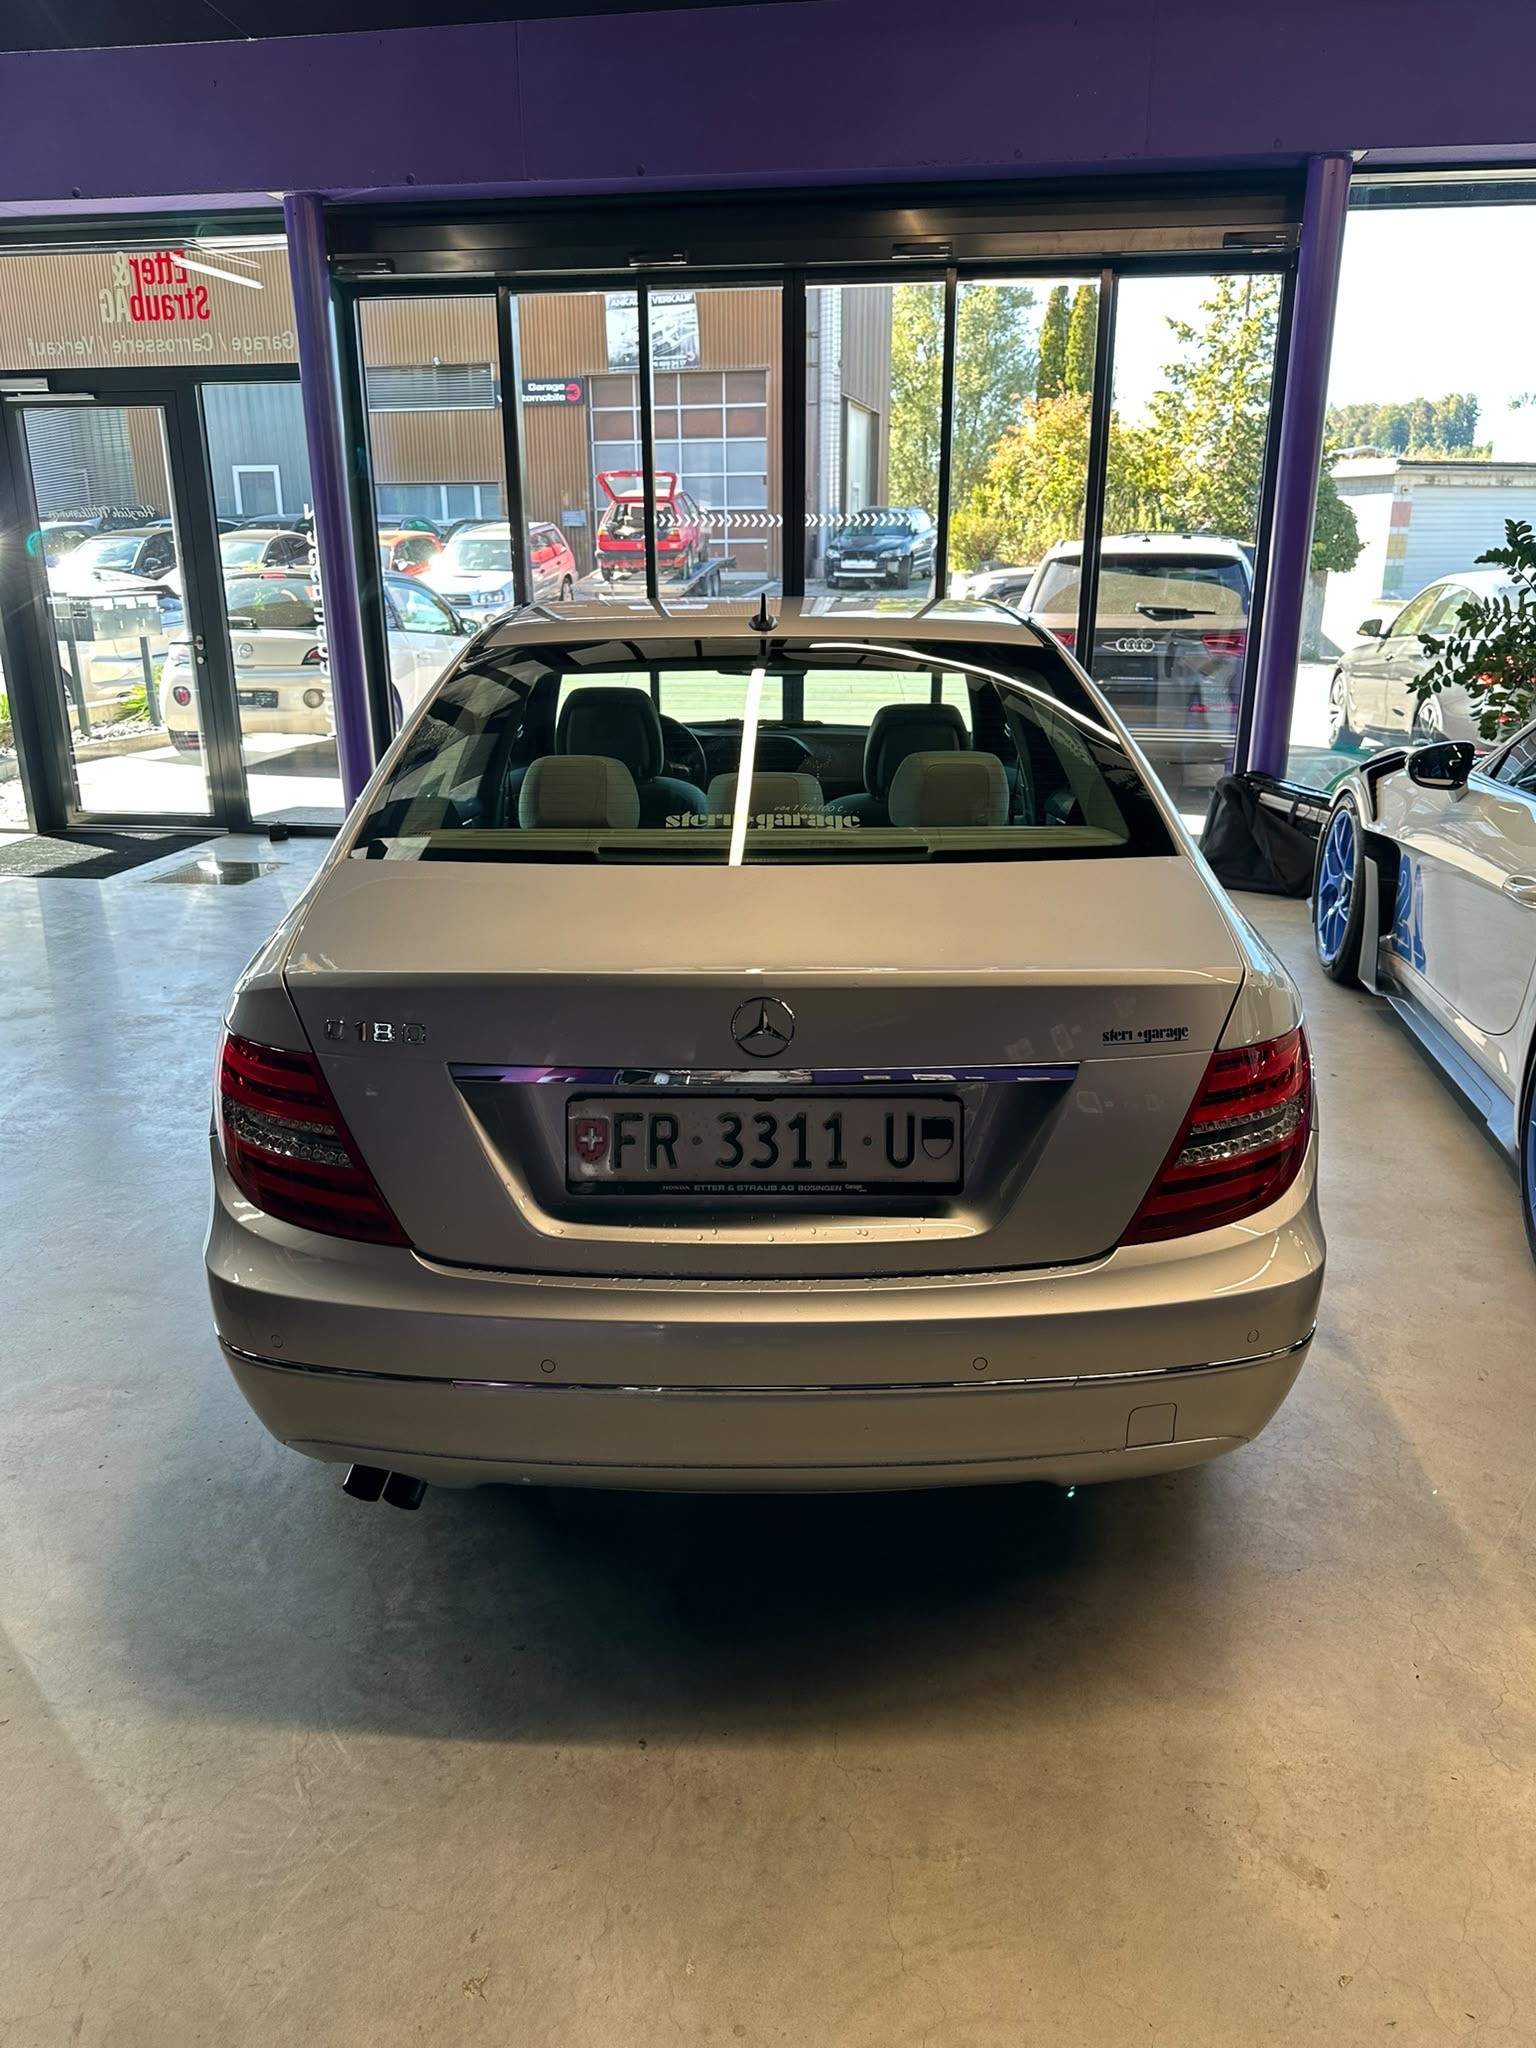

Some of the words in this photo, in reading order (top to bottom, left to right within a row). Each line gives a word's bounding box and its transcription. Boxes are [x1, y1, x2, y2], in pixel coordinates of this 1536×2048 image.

[652, 294, 693, 305] VERKAUF
[528, 383, 565, 392] Garage
[522, 394, 565, 402] tomobile
[355, 1021, 426, 1044] 180
[613, 1112, 680, 1170] FR
[715, 1112, 848, 1170] 3311
[884, 1112, 916, 1169] U
[694, 1184, 725, 1192] ETTER
[727, 1184, 735, 1192] &
[737, 1184, 778, 1192] STRAUB
[780, 1184, 795, 1192] AG
